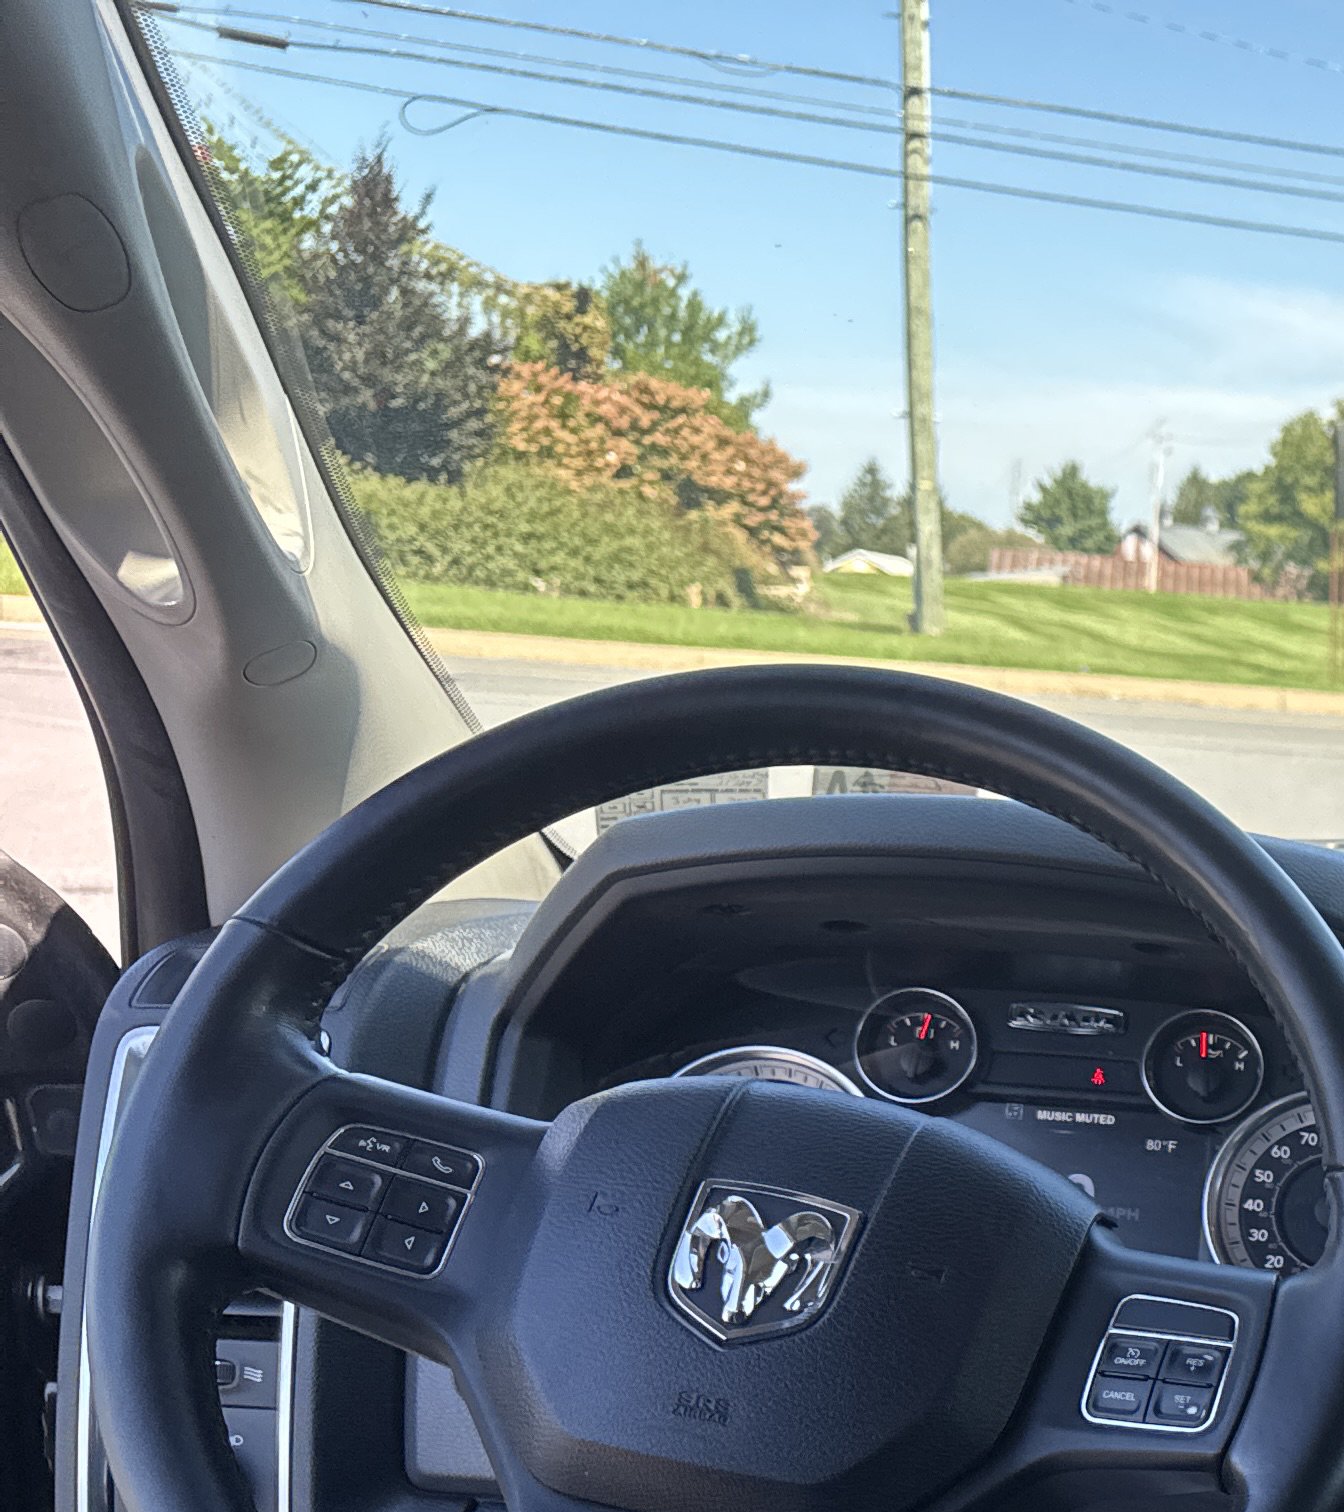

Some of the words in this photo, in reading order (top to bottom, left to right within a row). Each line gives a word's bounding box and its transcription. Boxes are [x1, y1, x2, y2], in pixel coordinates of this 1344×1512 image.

[949, 1039, 960, 1051] H
[1235, 1060, 1245, 1072] H
[1036, 1109, 1073, 1123] MUSIC
[1075, 1112, 1116, 1126] MUTED
[1300, 1131, 1318, 1146] 70
[1271, 1145, 1291, 1159] 60
[1254, 1169, 1274, 1183] 50
[1243, 1199, 1264, 1212] 40
[1248, 1229, 1269, 1242] 30
[1264, 1255, 1284, 1269] 20
[1186, 1358, 1205, 1367] RES
[1102, 1390, 1136, 1402] CANCEL
[1174, 1394, 1192, 1403] SET
